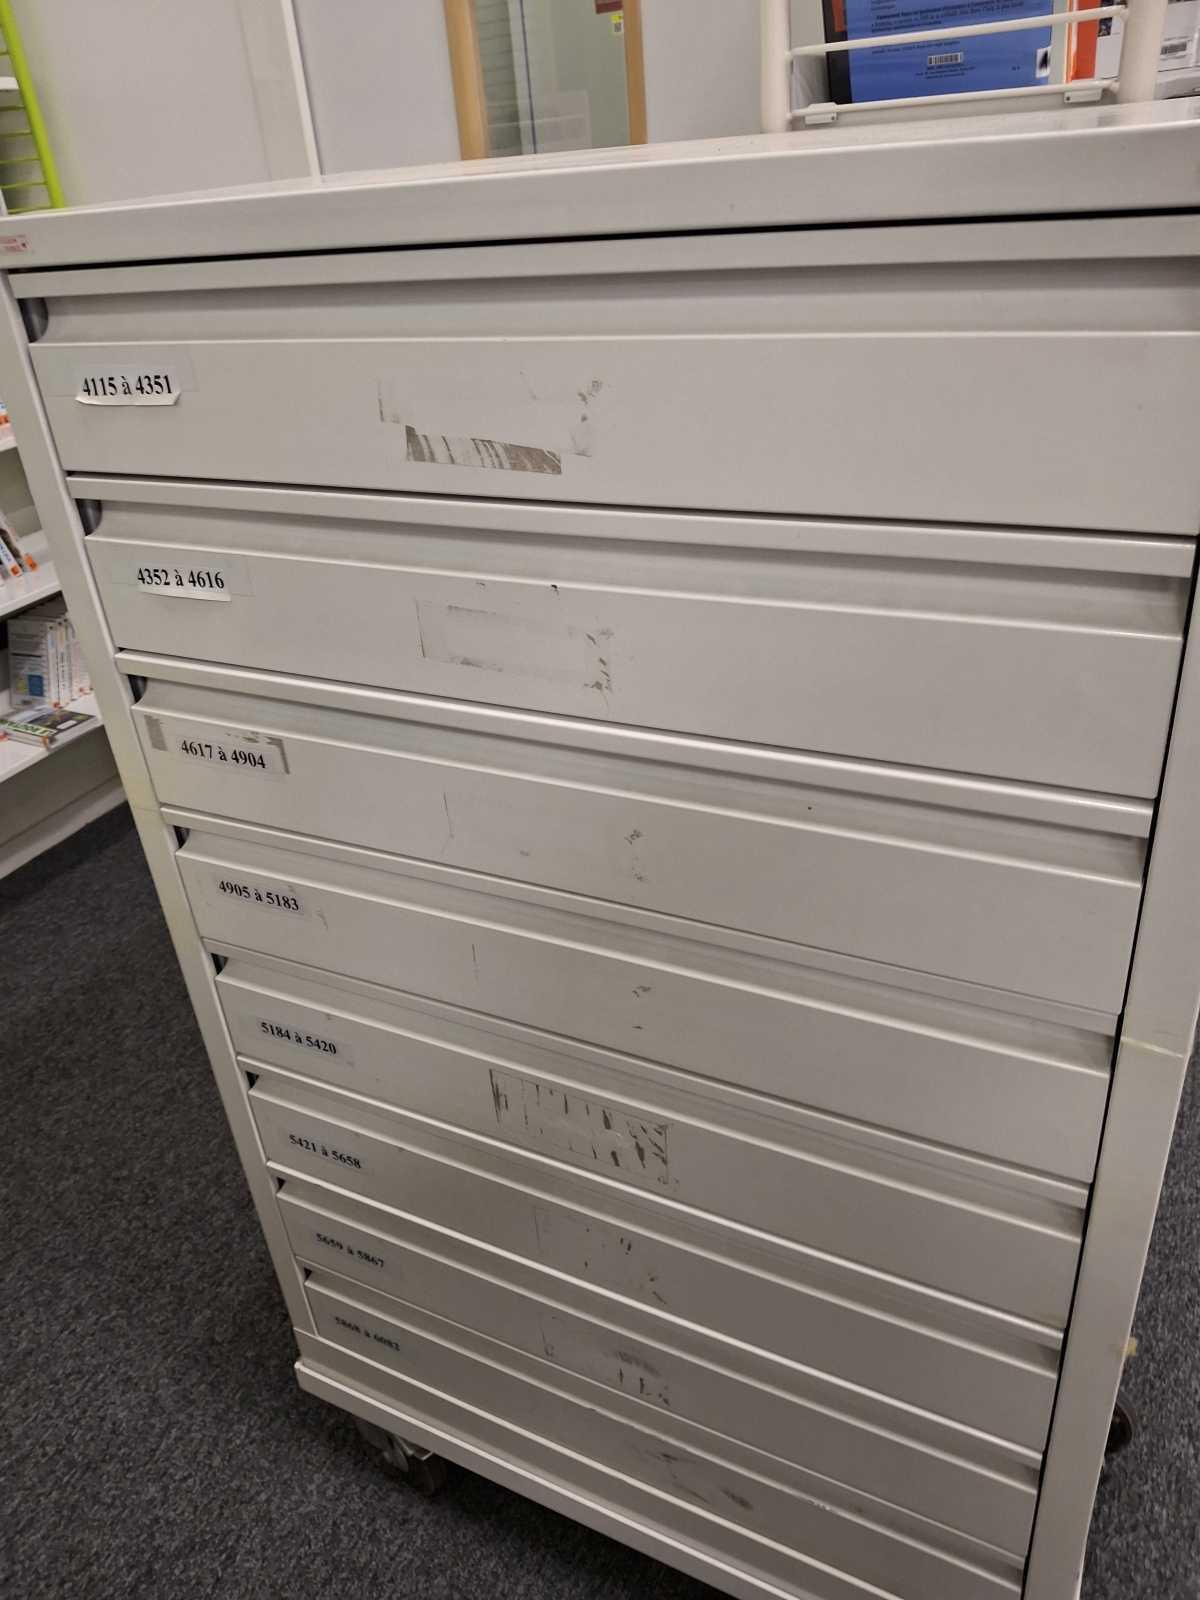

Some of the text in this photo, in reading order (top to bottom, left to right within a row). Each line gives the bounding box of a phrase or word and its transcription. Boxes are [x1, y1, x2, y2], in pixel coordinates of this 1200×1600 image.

[82, 374, 172, 397] 4115 à 4351
[137, 566, 225, 589] 4352 à 4616
[181, 739, 266, 769] 4617 à 4904
[218, 879, 300, 911] 4905 à 5183
[260, 1021, 337, 1055] 5184 à 5420
[288, 1134, 362, 1170] 5421 à 5658
[315, 1232, 344, 1250] 5659
[346, 1244, 355, 1256] à
